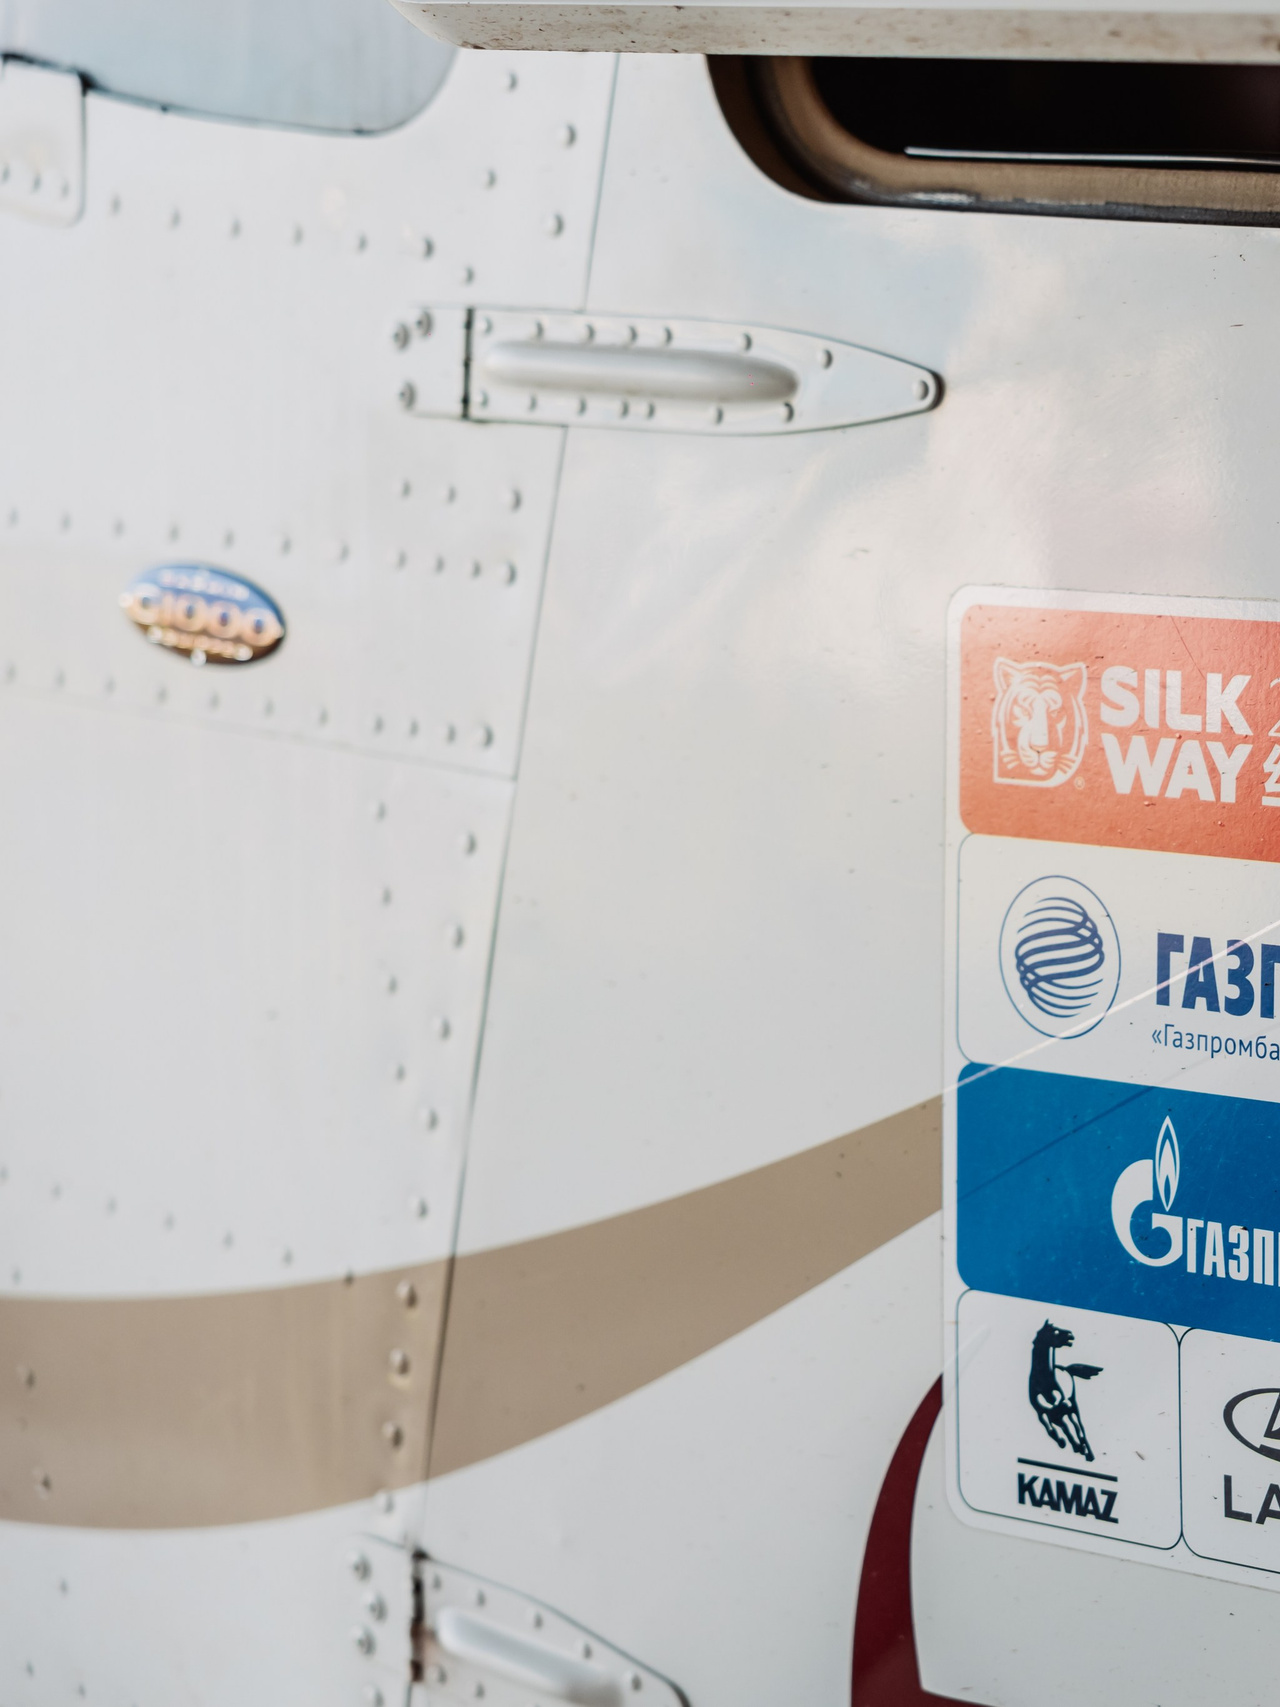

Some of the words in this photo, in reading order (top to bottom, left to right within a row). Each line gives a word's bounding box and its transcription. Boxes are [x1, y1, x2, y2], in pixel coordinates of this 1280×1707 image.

[1100, 665, 1253, 737] SILK
[1101, 734, 1253, 804] WAY
[1016, 1472, 1119, 1524] KAMAZ
